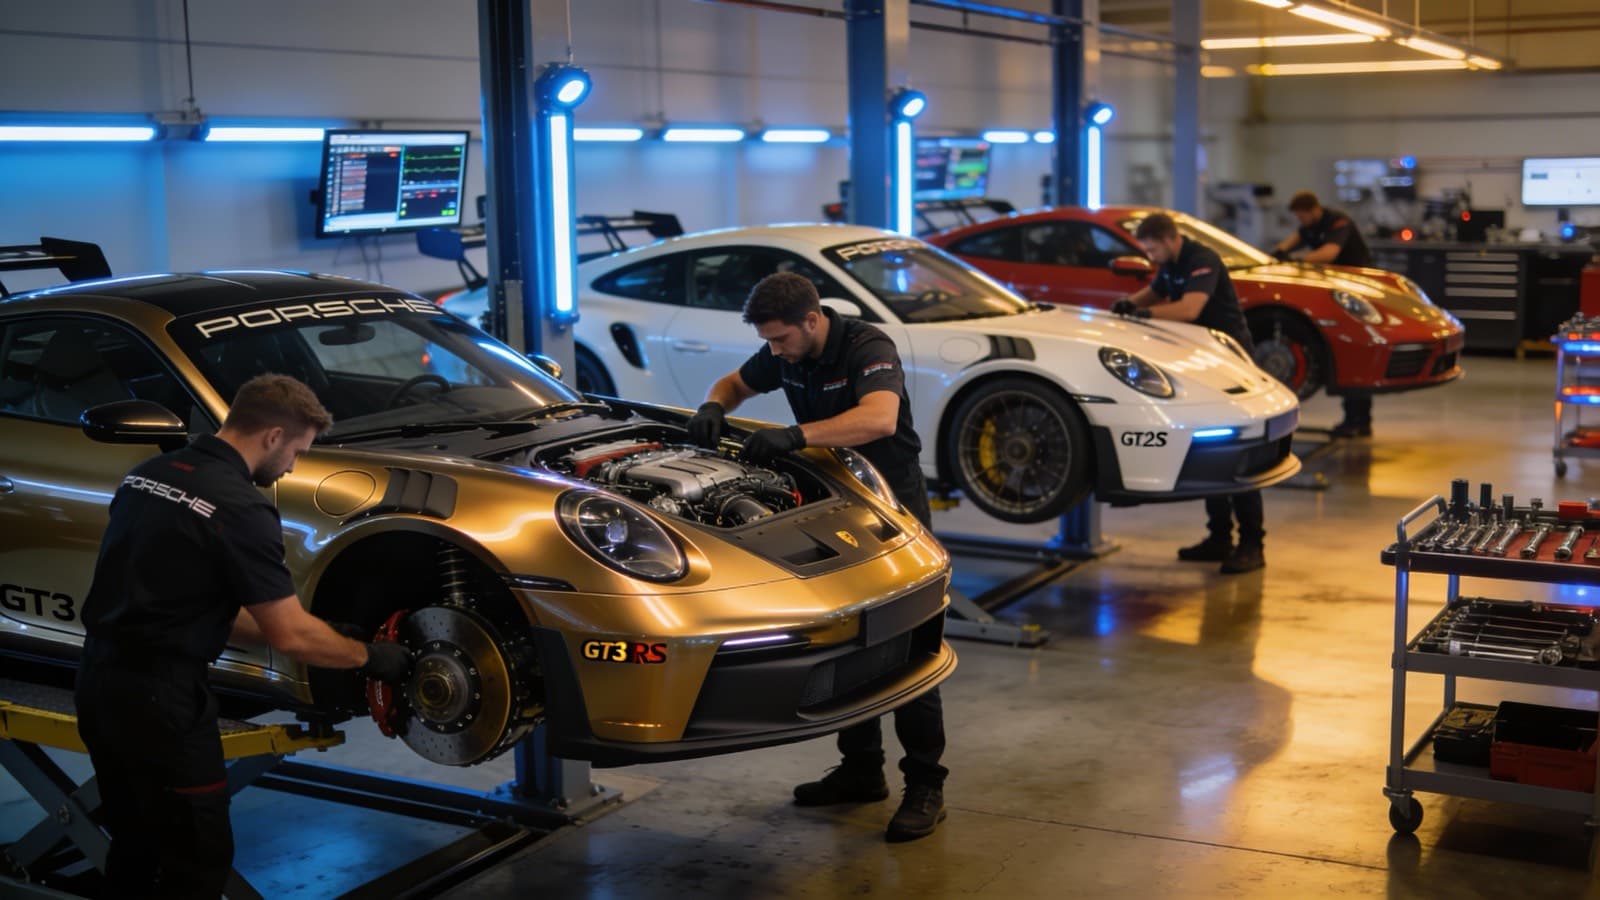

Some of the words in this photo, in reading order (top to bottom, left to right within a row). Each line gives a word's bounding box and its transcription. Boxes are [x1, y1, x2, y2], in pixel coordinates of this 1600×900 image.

[195, 298, 444, 339] PORSCHE
[1121, 431, 1168, 447] GT2S
[120, 475, 217, 518] PORSCHE
[0, 583, 76, 622] GT3
[582, 640, 629, 662] GT3
[633, 642, 667, 664] RS
